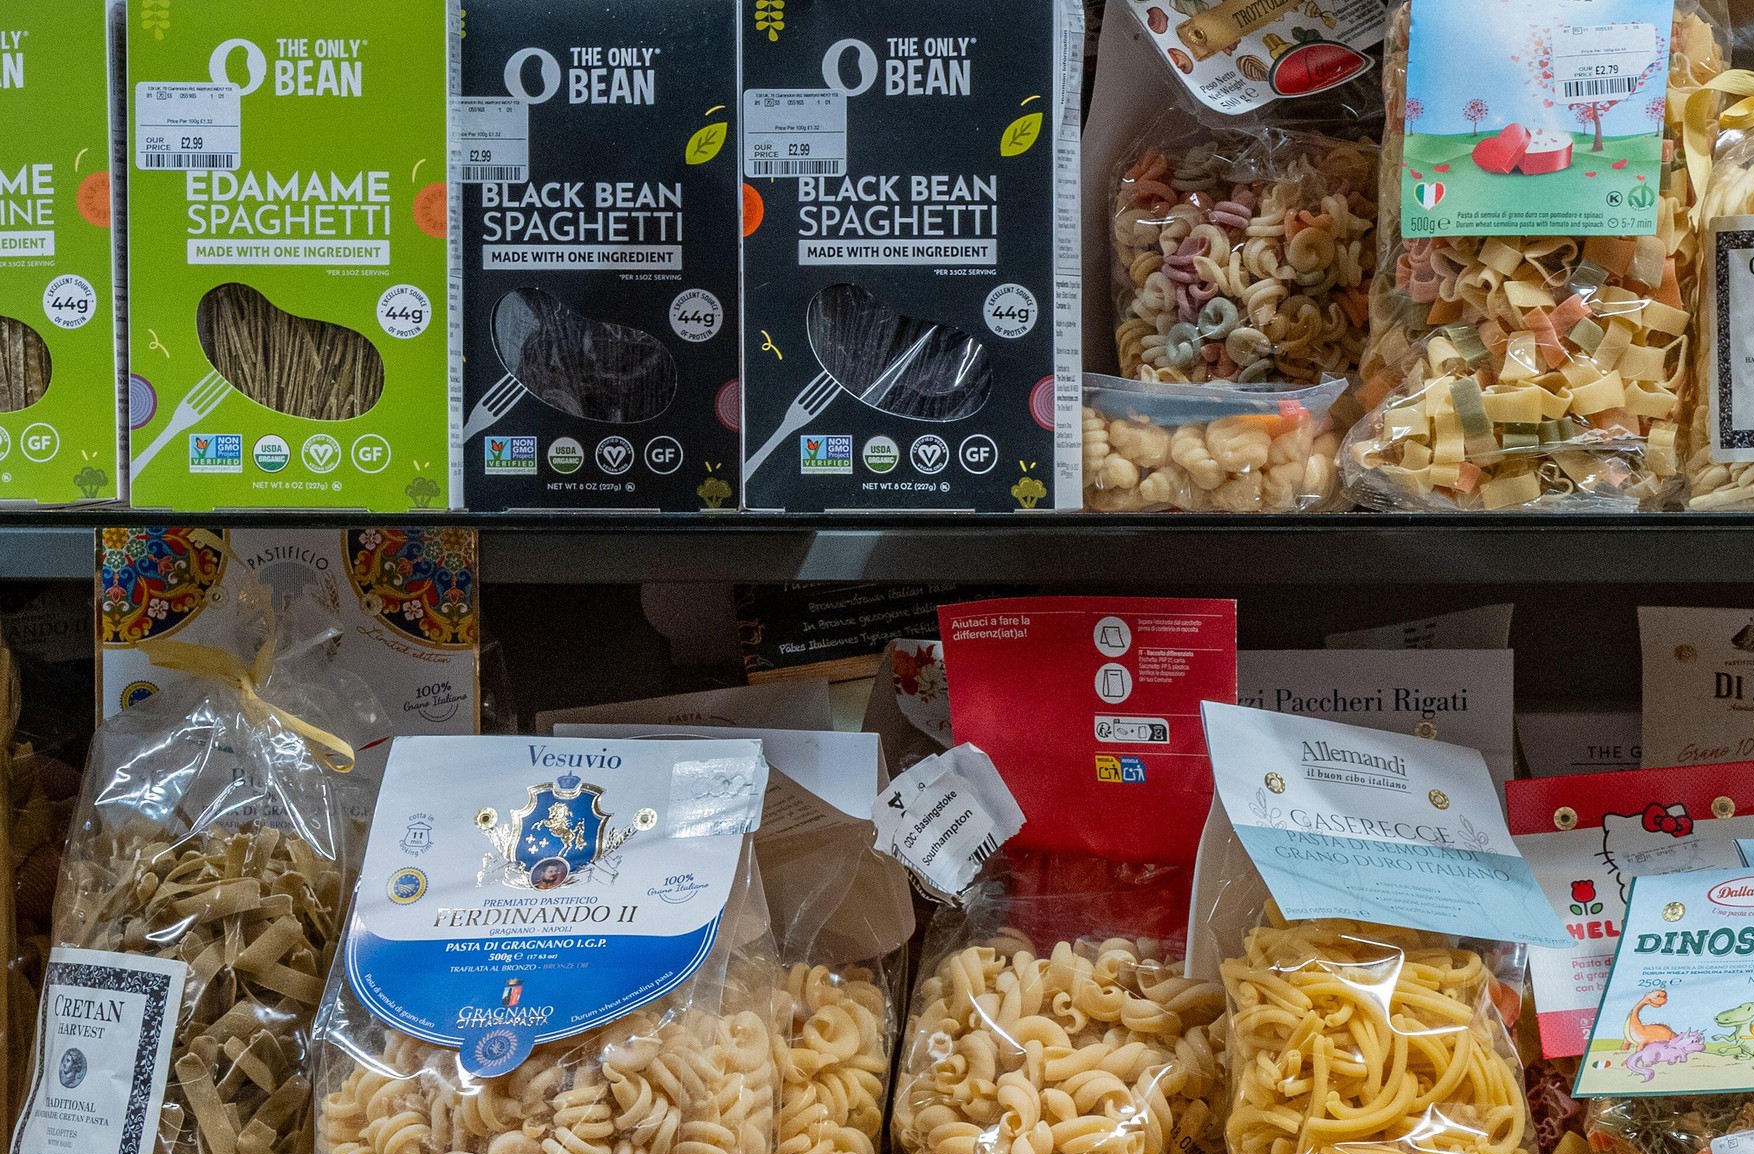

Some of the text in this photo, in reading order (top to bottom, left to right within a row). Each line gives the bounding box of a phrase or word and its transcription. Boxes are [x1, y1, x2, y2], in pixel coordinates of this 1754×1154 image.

[277, 39, 360, 58] THE ONLY
[1595, 64, 1619, 76] £2.79
[276, 63, 362, 97] BEAN
[181, 137, 203, 150] £2.99
[469, 149, 492, 162] £2.99
[187, 172, 389, 201] EDAMAME
[483, 183, 682, 208] BLACK BEAN
[799, 176, 996, 201] BLACK BEAN
[187, 206, 390, 235] SPAGHETTI
[483, 212, 682, 241] SPAGHETTI
[799, 205, 997, 235] SPAGHETTI
[1411, 218, 1436, 232] 500g
[196, 246, 380, 258] MADE WITH ONE INGREDIENT
[385, 305, 423, 324] 44g
[678, 309, 715, 328] 44g
[218, 436, 239, 444] NON
[218, 444, 239, 452] GMO
[261, 445, 282, 453] USDA
[358, 447, 383, 462] GF
[652, 448, 675, 461] GF
[1714, 672, 1742, 699] DI
[1275, 688, 1468, 720] Paccheri Rigati
[528, 744, 621, 770] Vesuvio
[1302, 741, 1406, 776] Allemandi
[914, 790, 958, 840] Basingstoke
[1290, 809, 1455, 844] CASERECCE
[922, 809, 973, 867] Southampton
[484, 896, 598, 907] PREMIATO PASTIFICIO
[1716, 885, 1754, 900] Dalla
[433, 906, 638, 928] FERDINANDO II
[445, 939, 607, 952] PASTA DI GRAGNANO I.G.P.
[488, 953, 513, 963] 500g
[1638, 977, 1667, 988] 250g
[54, 993, 125, 1023] CRETAN
[459, 1005, 554, 1018] GRAGNANO
[58, 1022, 105, 1038] HARVEST
